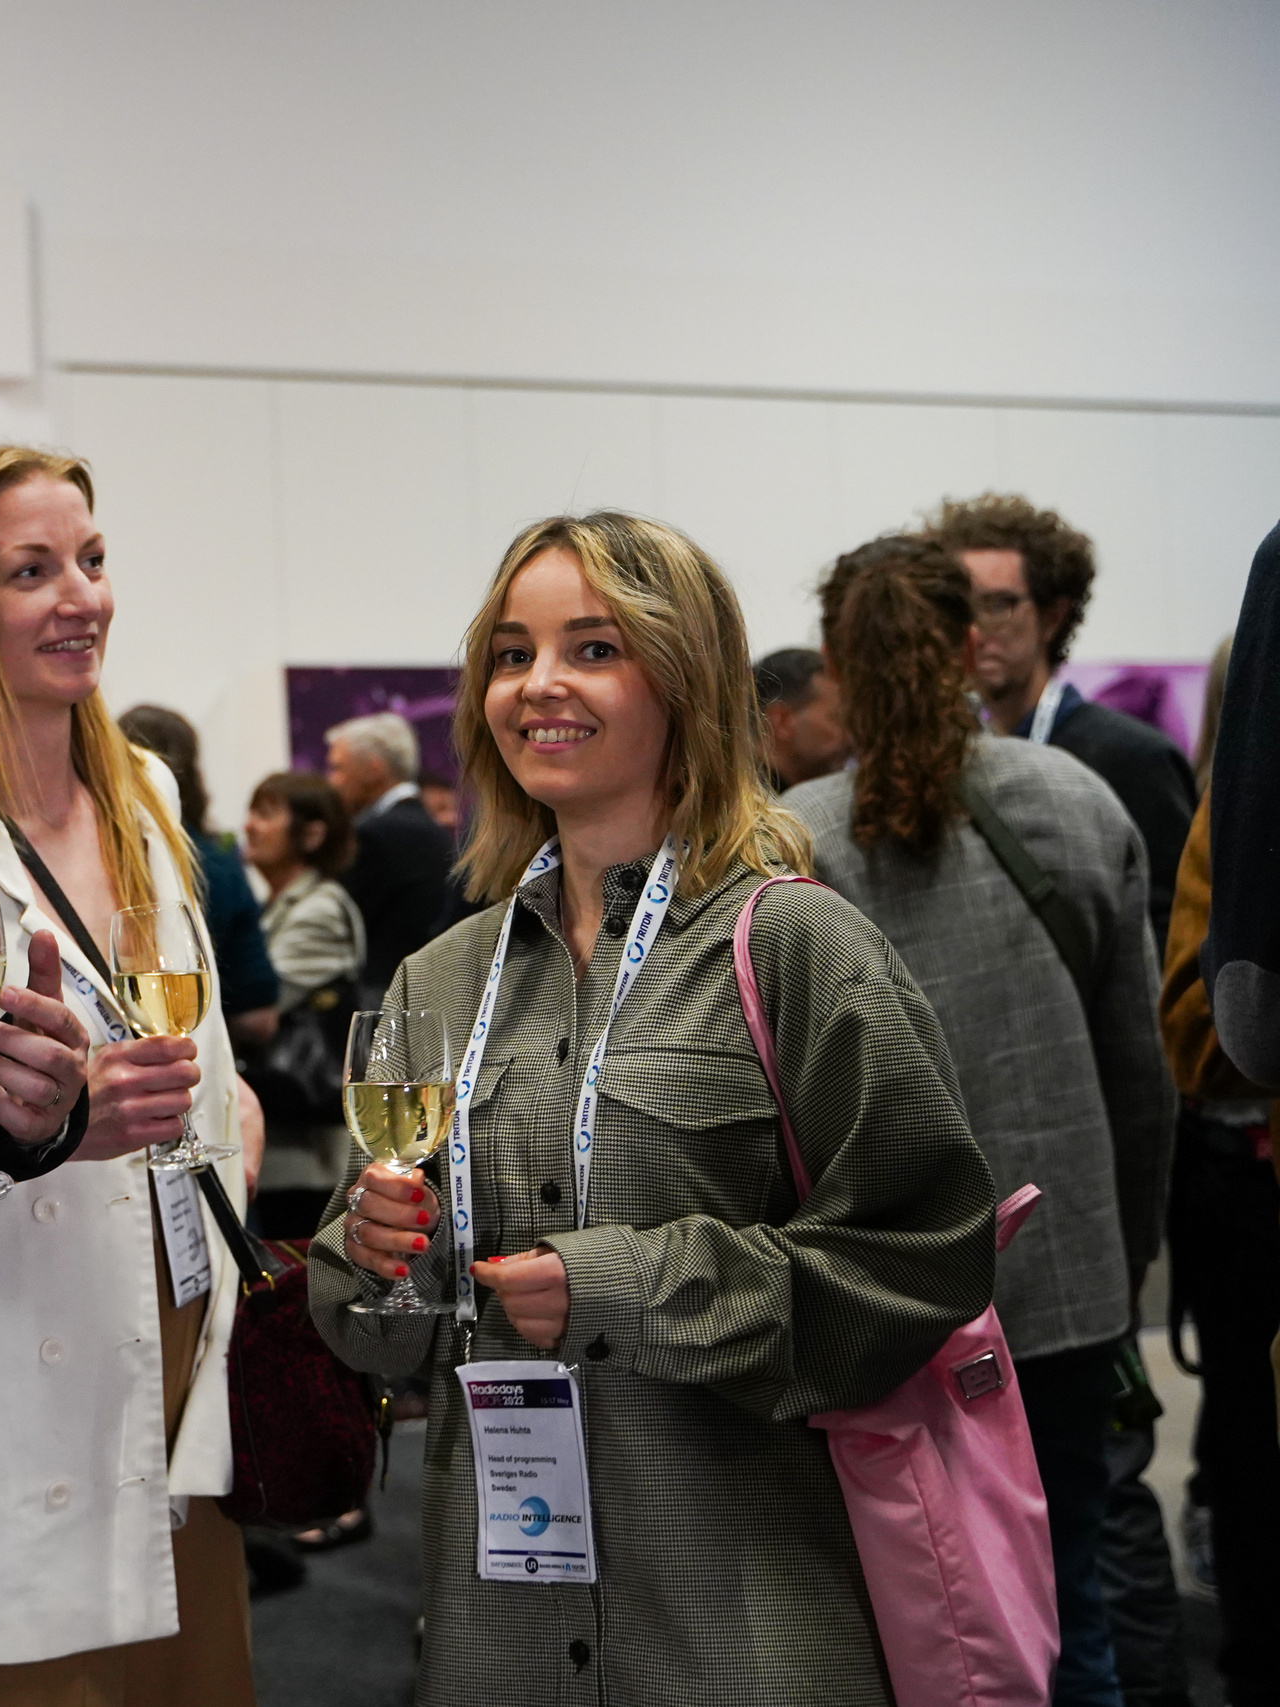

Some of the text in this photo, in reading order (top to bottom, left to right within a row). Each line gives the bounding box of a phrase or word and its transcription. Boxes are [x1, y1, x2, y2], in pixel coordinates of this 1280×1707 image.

[657, 857, 675, 883] TRITON
[636, 911, 654, 941] TRITON
[617, 970, 630, 1000] TRITON
[480, 991, 492, 1019] TRITON
[463, 1050, 476, 1078] TRITON
[581, 1096, 590, 1128] TRITON
[470, 1384, 524, 1396] Radiodays
[502, 1396, 524, 1406] 2022
[484, 1426, 508, 1434] Helena
[488, 1455, 505, 1463] Head
[514, 1456, 557, 1465] programming
[490, 1470, 538, 1479] Sveriges Radio
[491, 1484, 517, 1492] Sweden
